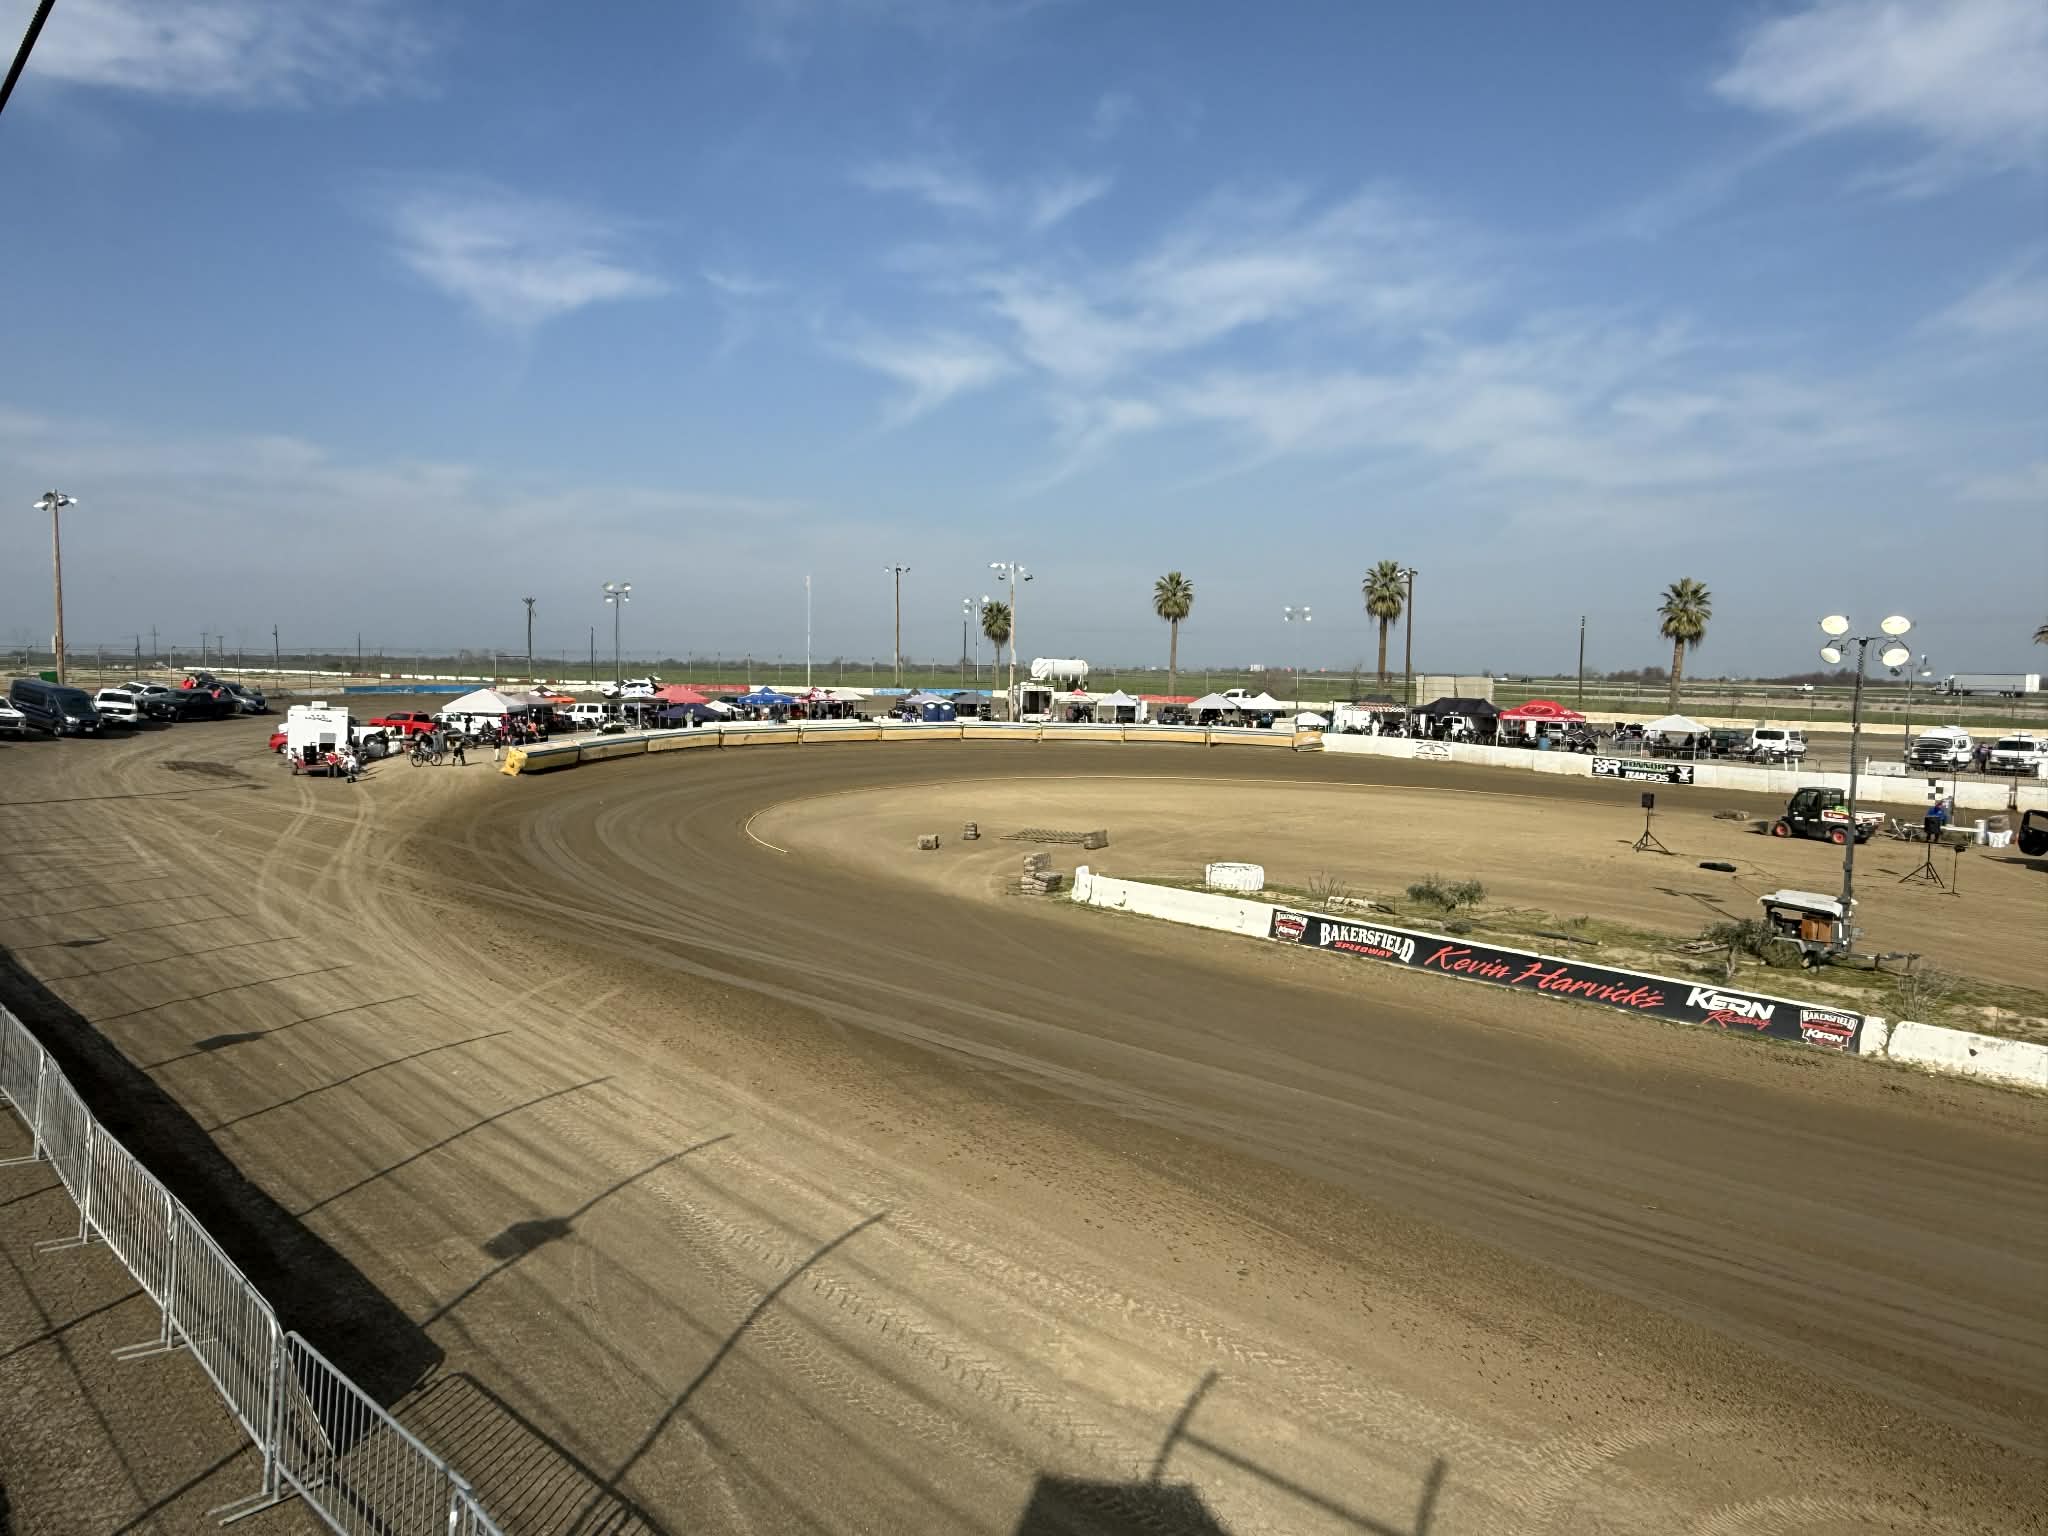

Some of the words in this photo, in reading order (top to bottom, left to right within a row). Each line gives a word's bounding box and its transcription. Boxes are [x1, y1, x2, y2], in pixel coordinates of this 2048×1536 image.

[1319, 922, 1415, 963] BAKERSFIELD
[1424, 946, 1511, 978] Kevin
[1511, 962, 1665, 1008] Harvick's
[1686, 986, 1775, 1020] KERN
[1803, 1010, 1857, 1030] BAKERSFIELD
[1806, 1028, 1844, 1043] KERN
